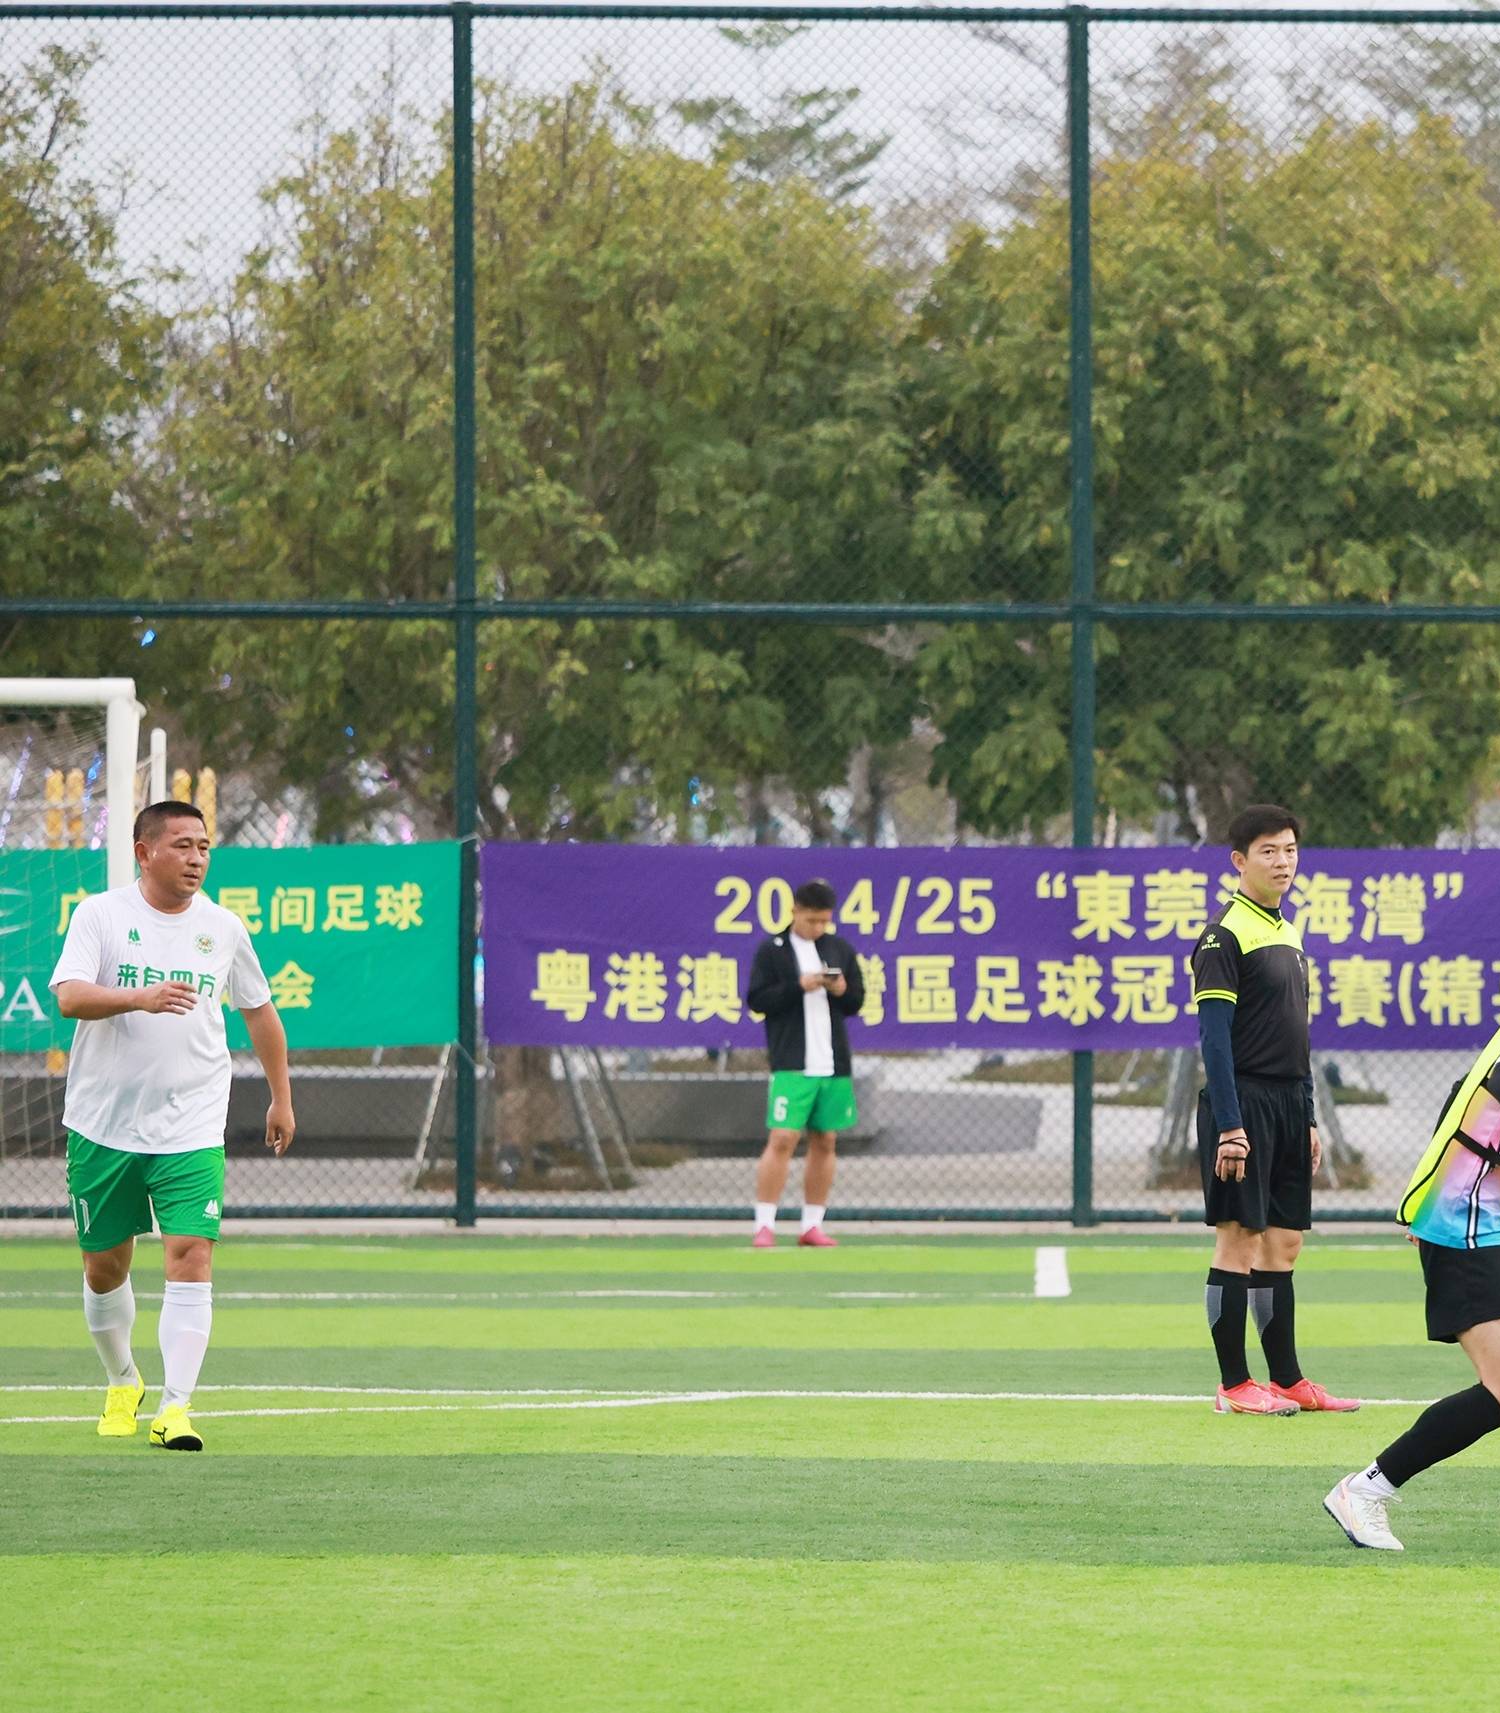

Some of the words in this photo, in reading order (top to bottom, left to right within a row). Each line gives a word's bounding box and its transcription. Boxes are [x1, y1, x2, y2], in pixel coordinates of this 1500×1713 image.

[714, 876, 997, 941] 204/25
[1036, 869, 1465, 945] “東莞海灣”
[773, 1096, 789, 1122] 6
